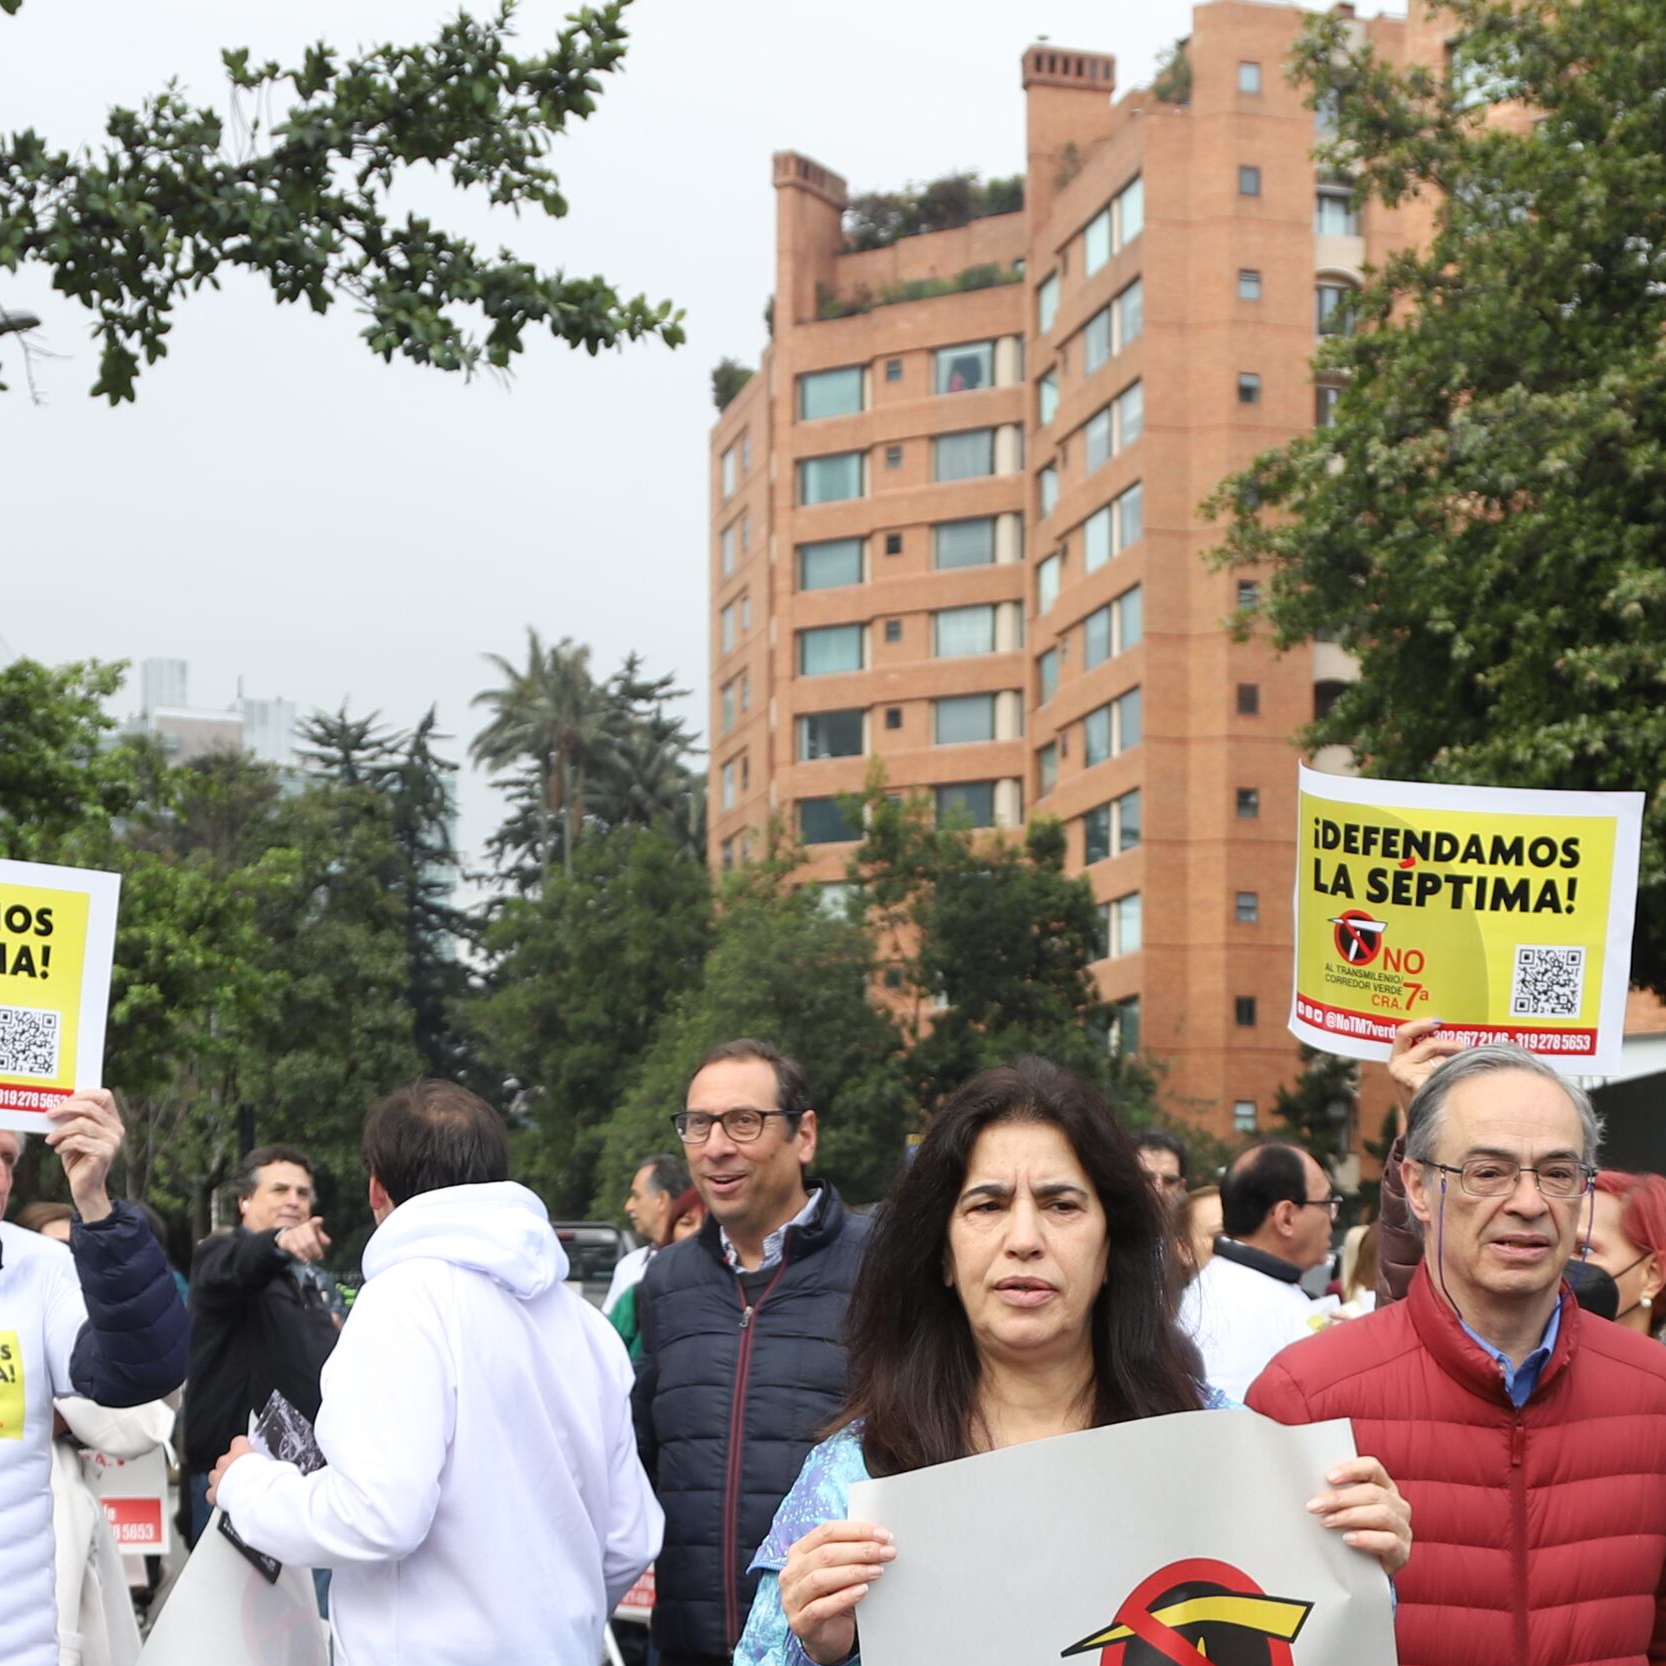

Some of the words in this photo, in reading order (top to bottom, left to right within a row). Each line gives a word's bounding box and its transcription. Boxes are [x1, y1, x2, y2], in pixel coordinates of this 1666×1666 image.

[1313, 817, 1581, 869] ¡DEFENDAMOS
[1313, 857, 1354, 900] LA
[1366, 857, 1578, 915] SÉPTIMA!
[1325, 962, 1334, 973] AL
[1383, 947, 1425, 975] NO
[1325, 974, 1371, 990] CORREDOR
[1373, 983, 1403, 996] VERDE
